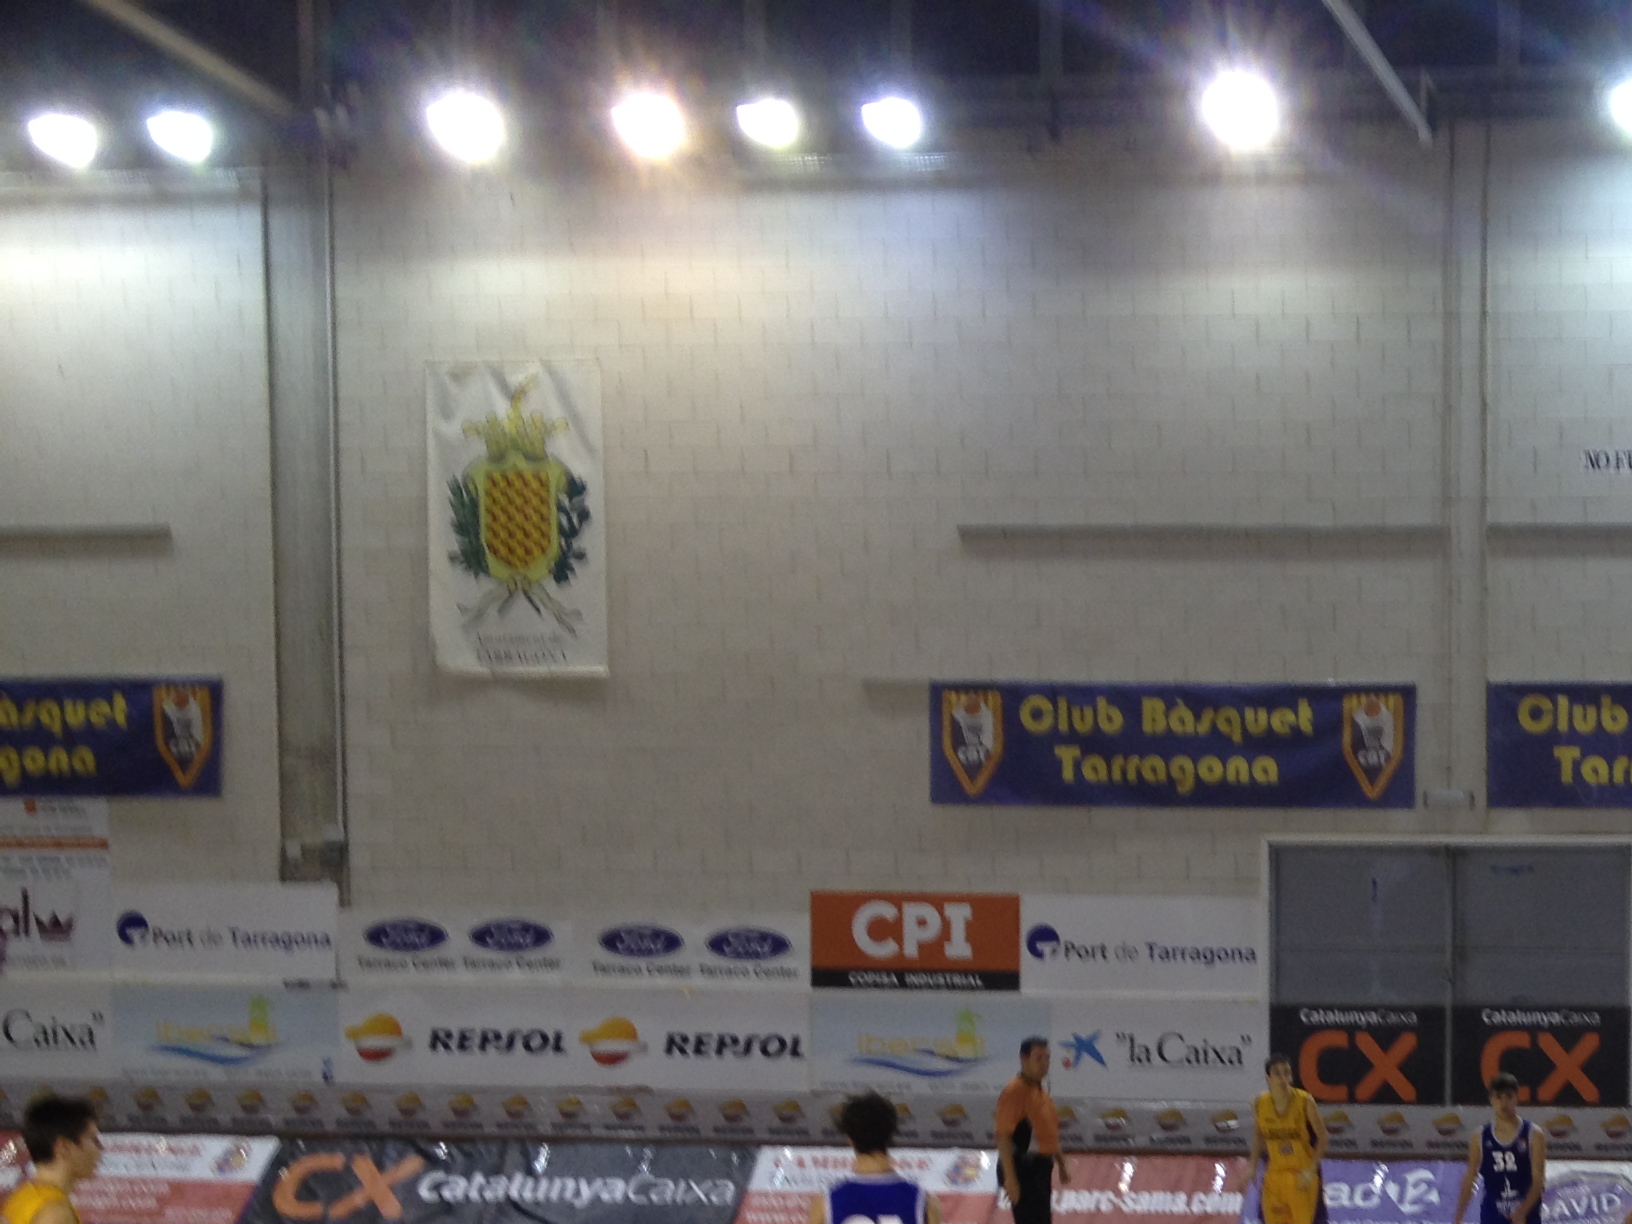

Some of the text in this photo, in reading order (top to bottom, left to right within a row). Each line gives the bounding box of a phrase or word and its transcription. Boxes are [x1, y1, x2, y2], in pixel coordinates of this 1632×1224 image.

[1019, 694, 1124, 736] Club
[1517, 694, 1629, 736] Club
[1054, 745, 1279, 795] Tarragona
[150, 925, 195, 950] Port
[227, 925, 333, 955] Tarragona
[851, 899, 973, 961] CPI
[1063, 939, 1108, 961] Port
[1144, 941, 1257, 966] Tarragona
[428, 1026, 568, 1055] REPSOL
[663, 1030, 805, 1060] REPSOL
[1299, 1029, 1418, 1103] CX
[1480, 1029, 1600, 1105] CX
[272, 1152, 425, 1221] CX
[416, 1168, 737, 1209] CatalunyaCaixa
